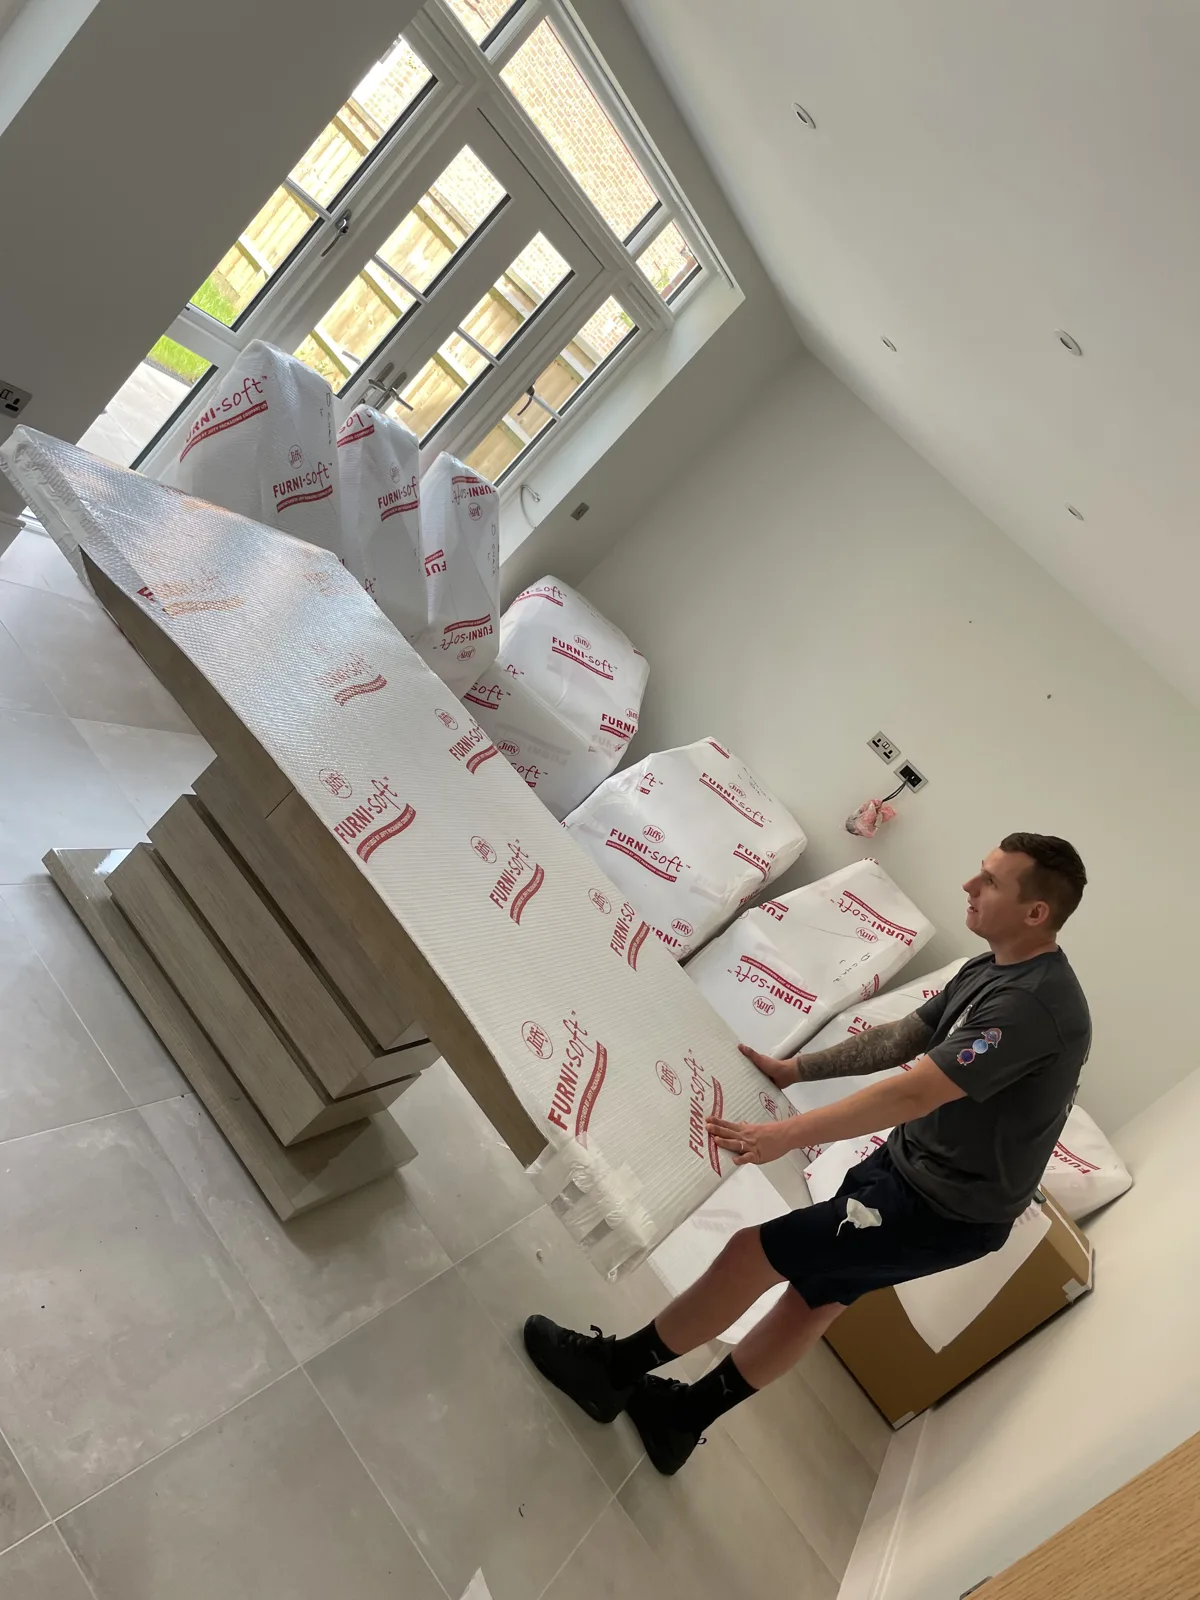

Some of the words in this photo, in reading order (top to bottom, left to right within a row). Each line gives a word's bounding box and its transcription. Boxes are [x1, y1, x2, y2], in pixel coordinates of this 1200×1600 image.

[643, 826, 664, 842] Jiffy
[672, 920, 692, 936] Jiffy
[754, 997, 774, 1014] Jiffy
